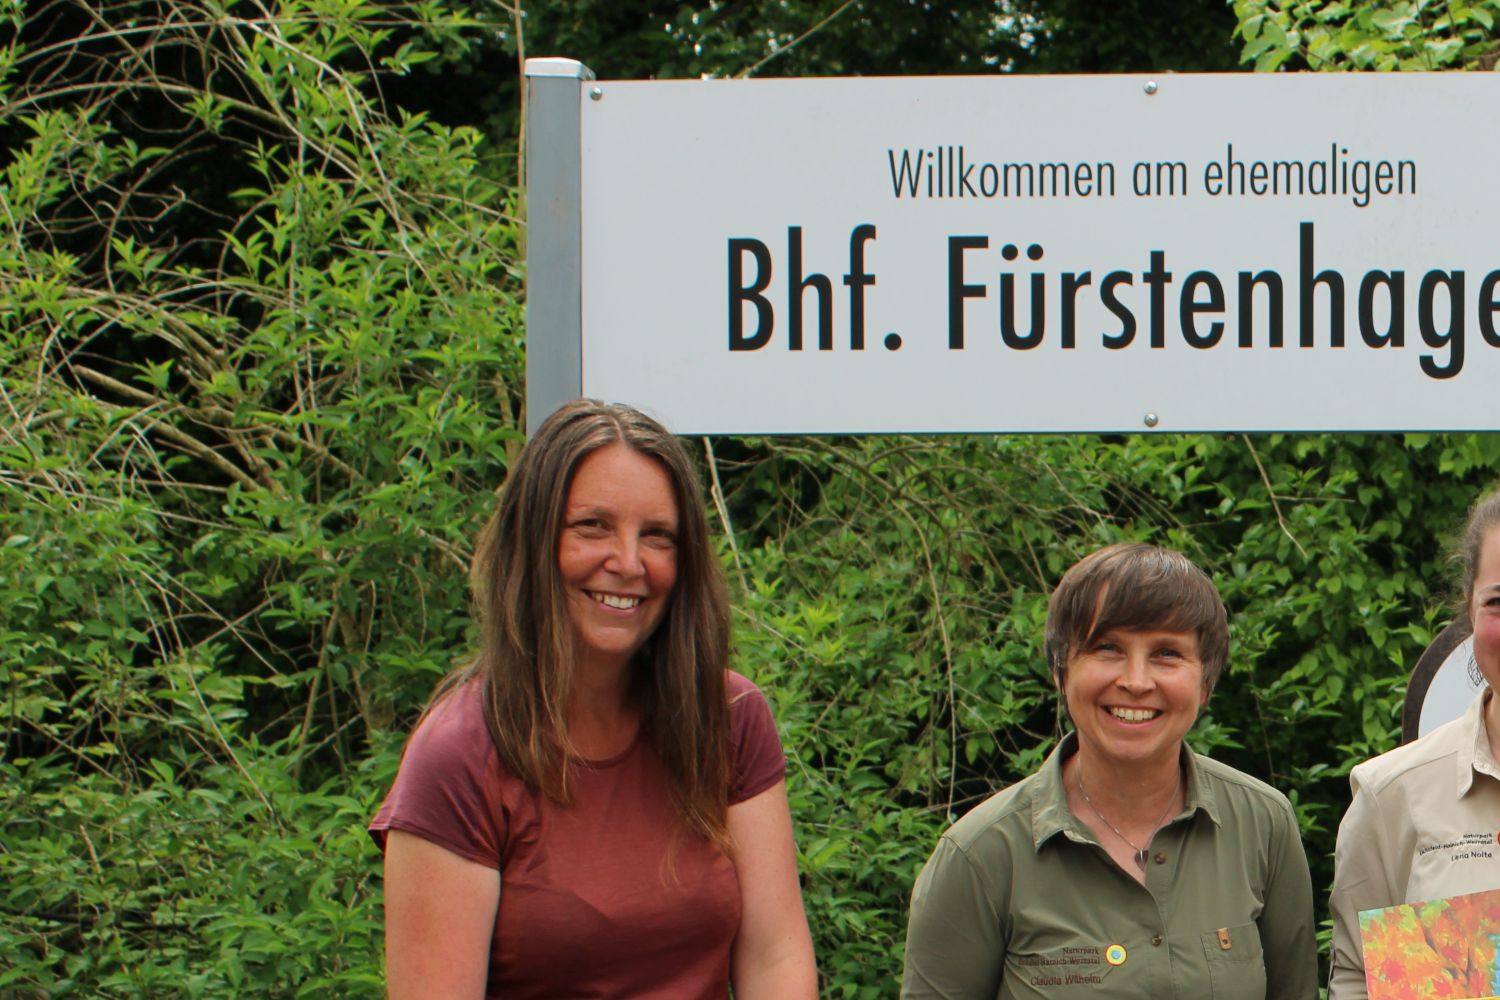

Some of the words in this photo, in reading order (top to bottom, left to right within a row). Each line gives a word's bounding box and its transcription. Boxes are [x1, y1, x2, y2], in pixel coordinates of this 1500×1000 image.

[888, 145, 1115, 199] Willkommen
[1132, 160, 1188, 198] am
[1203, 142, 1417, 208] ehemaligen
[727, 225, 903, 353] Bhf.
[1451, 852, 1469, 862] Lena
[1030, 976, 1062, 986] Claudia
[1065, 974, 1101, 984] Wilhelm
